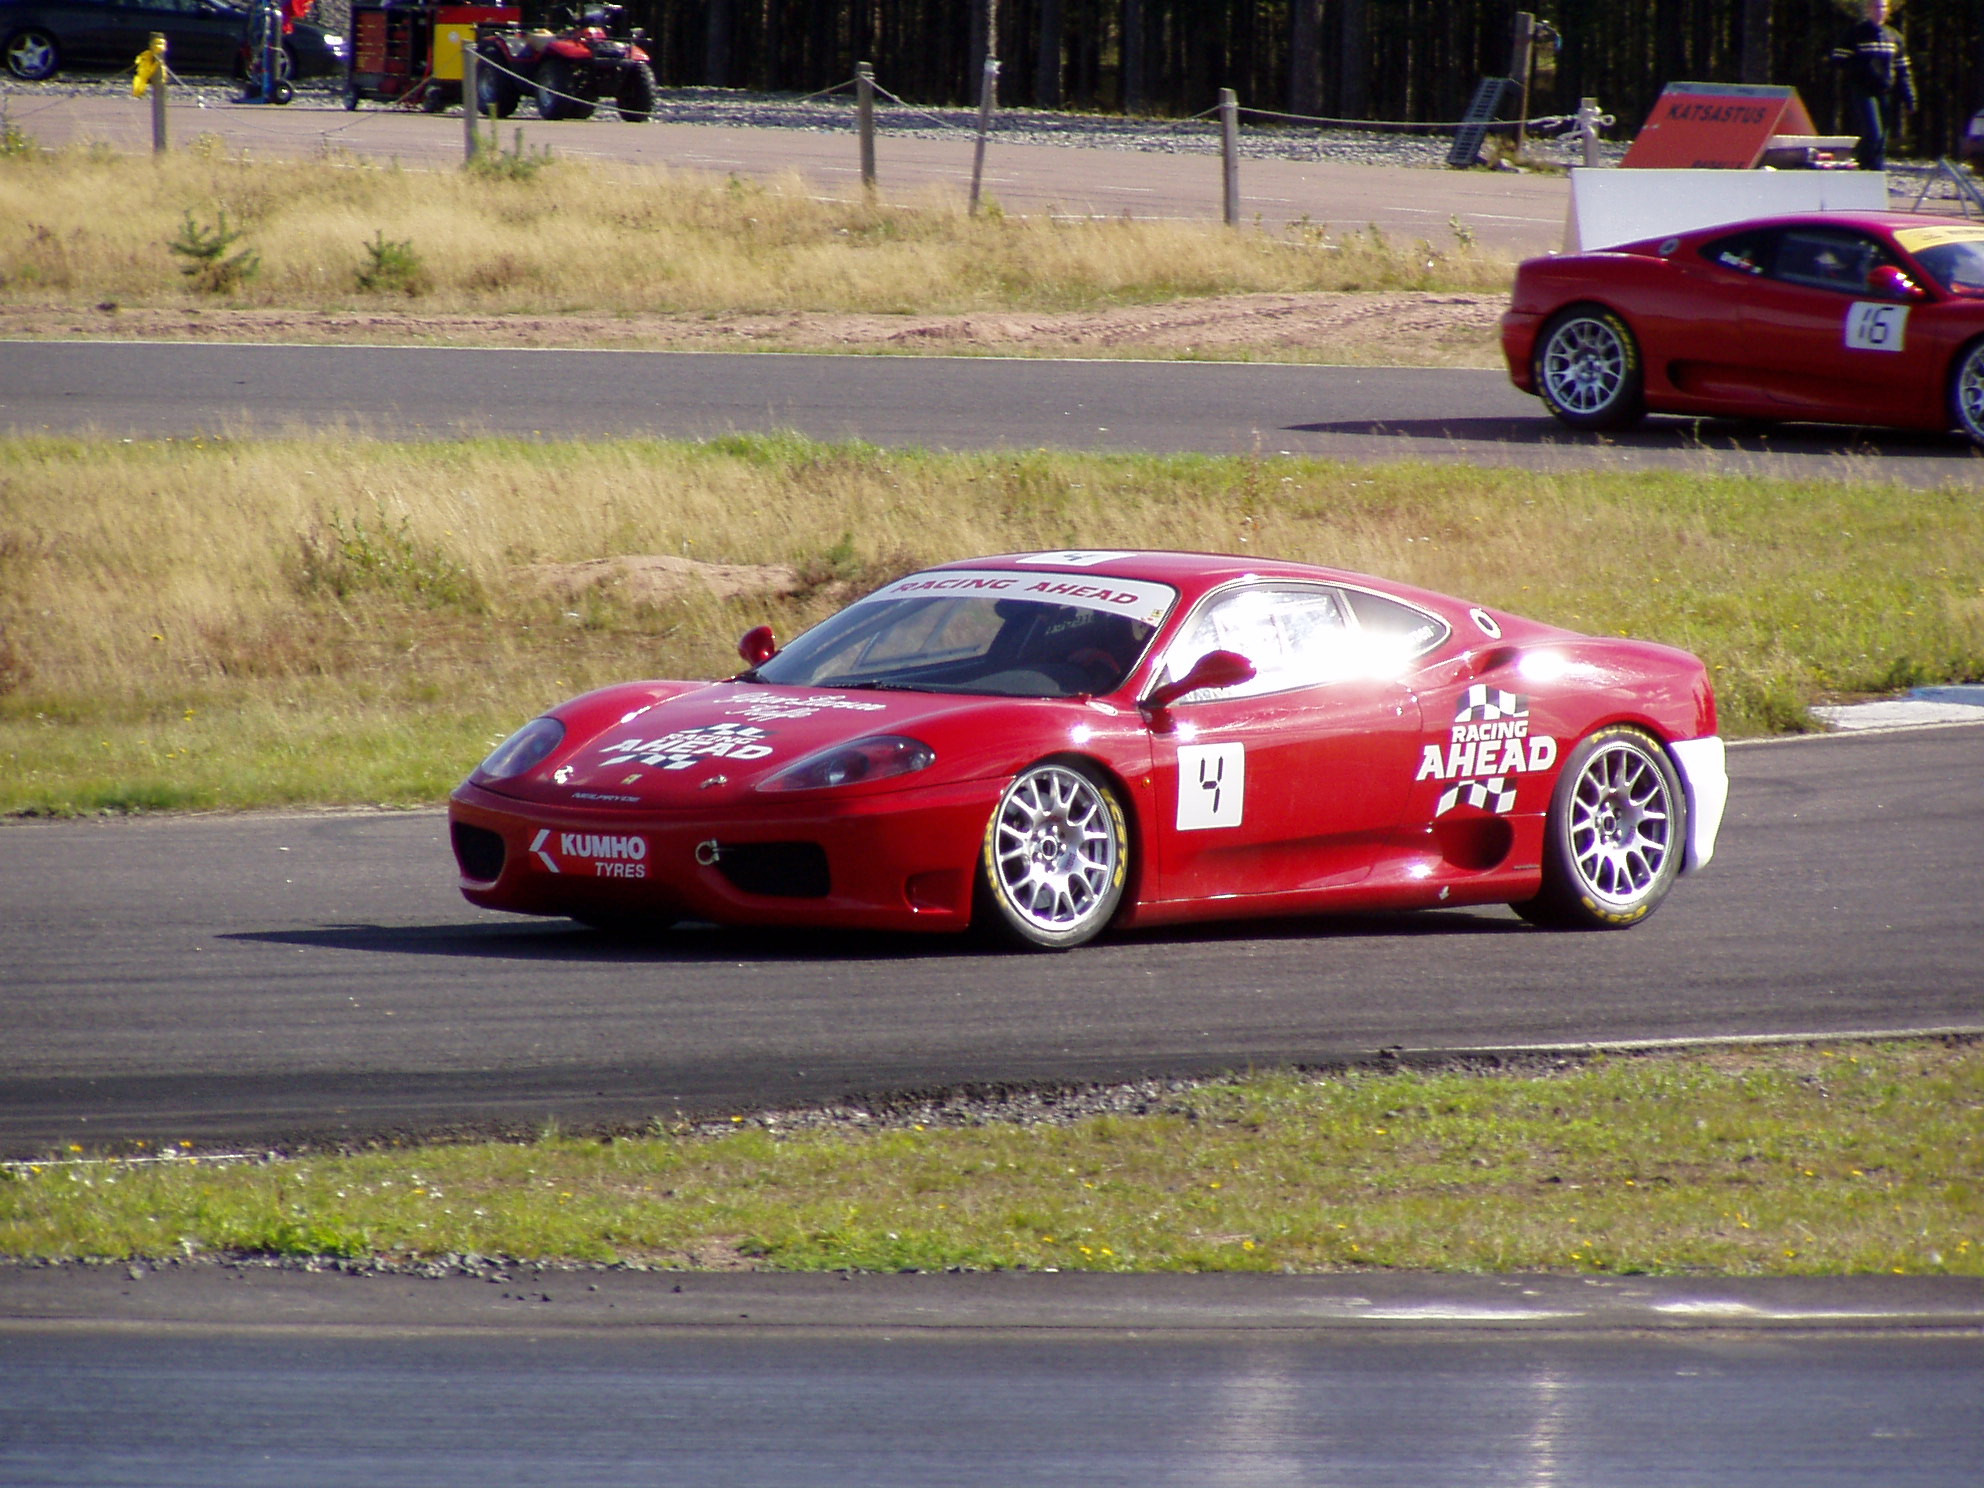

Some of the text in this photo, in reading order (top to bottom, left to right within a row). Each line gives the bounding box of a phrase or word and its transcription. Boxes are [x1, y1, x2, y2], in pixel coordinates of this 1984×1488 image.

[1666, 103, 1767, 124] KATSASTUS
[1858, 306, 1896, 344] 16
[889, 578, 1139, 605] RACING AHEAD
[662, 732, 758, 745] RACING
[1451, 719, 1529, 743] RACING
[598, 738, 774, 760] AHEAD
[1415, 735, 1558, 782] AHEAD
[1199, 755, 1224, 814] 4
[560, 832, 646, 860] KUMHO
[594, 861, 646, 878] TYRES
